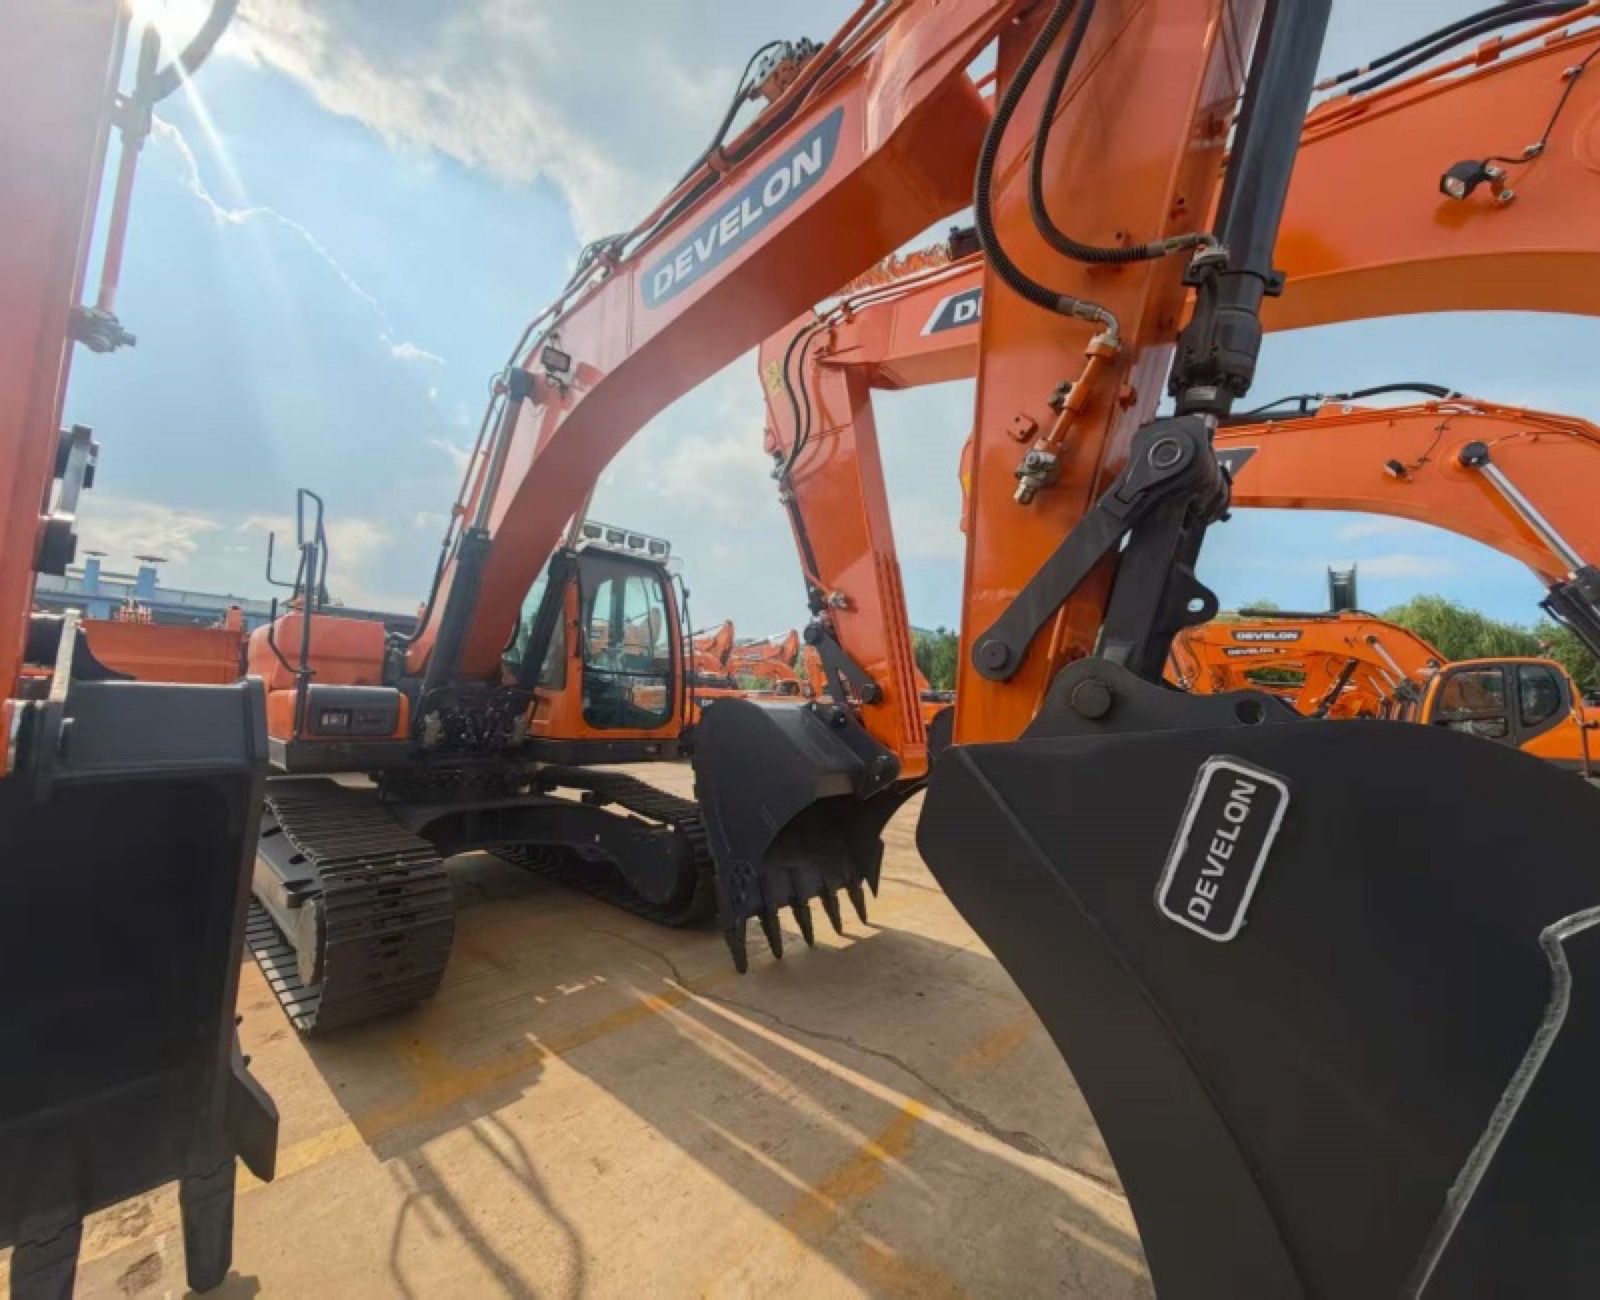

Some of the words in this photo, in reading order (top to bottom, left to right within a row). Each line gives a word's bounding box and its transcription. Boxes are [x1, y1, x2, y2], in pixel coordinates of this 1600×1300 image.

[652, 137, 823, 300] DEVELON
[954, 299, 982, 323] D
[1187, 779, 1257, 922] DEVELON
